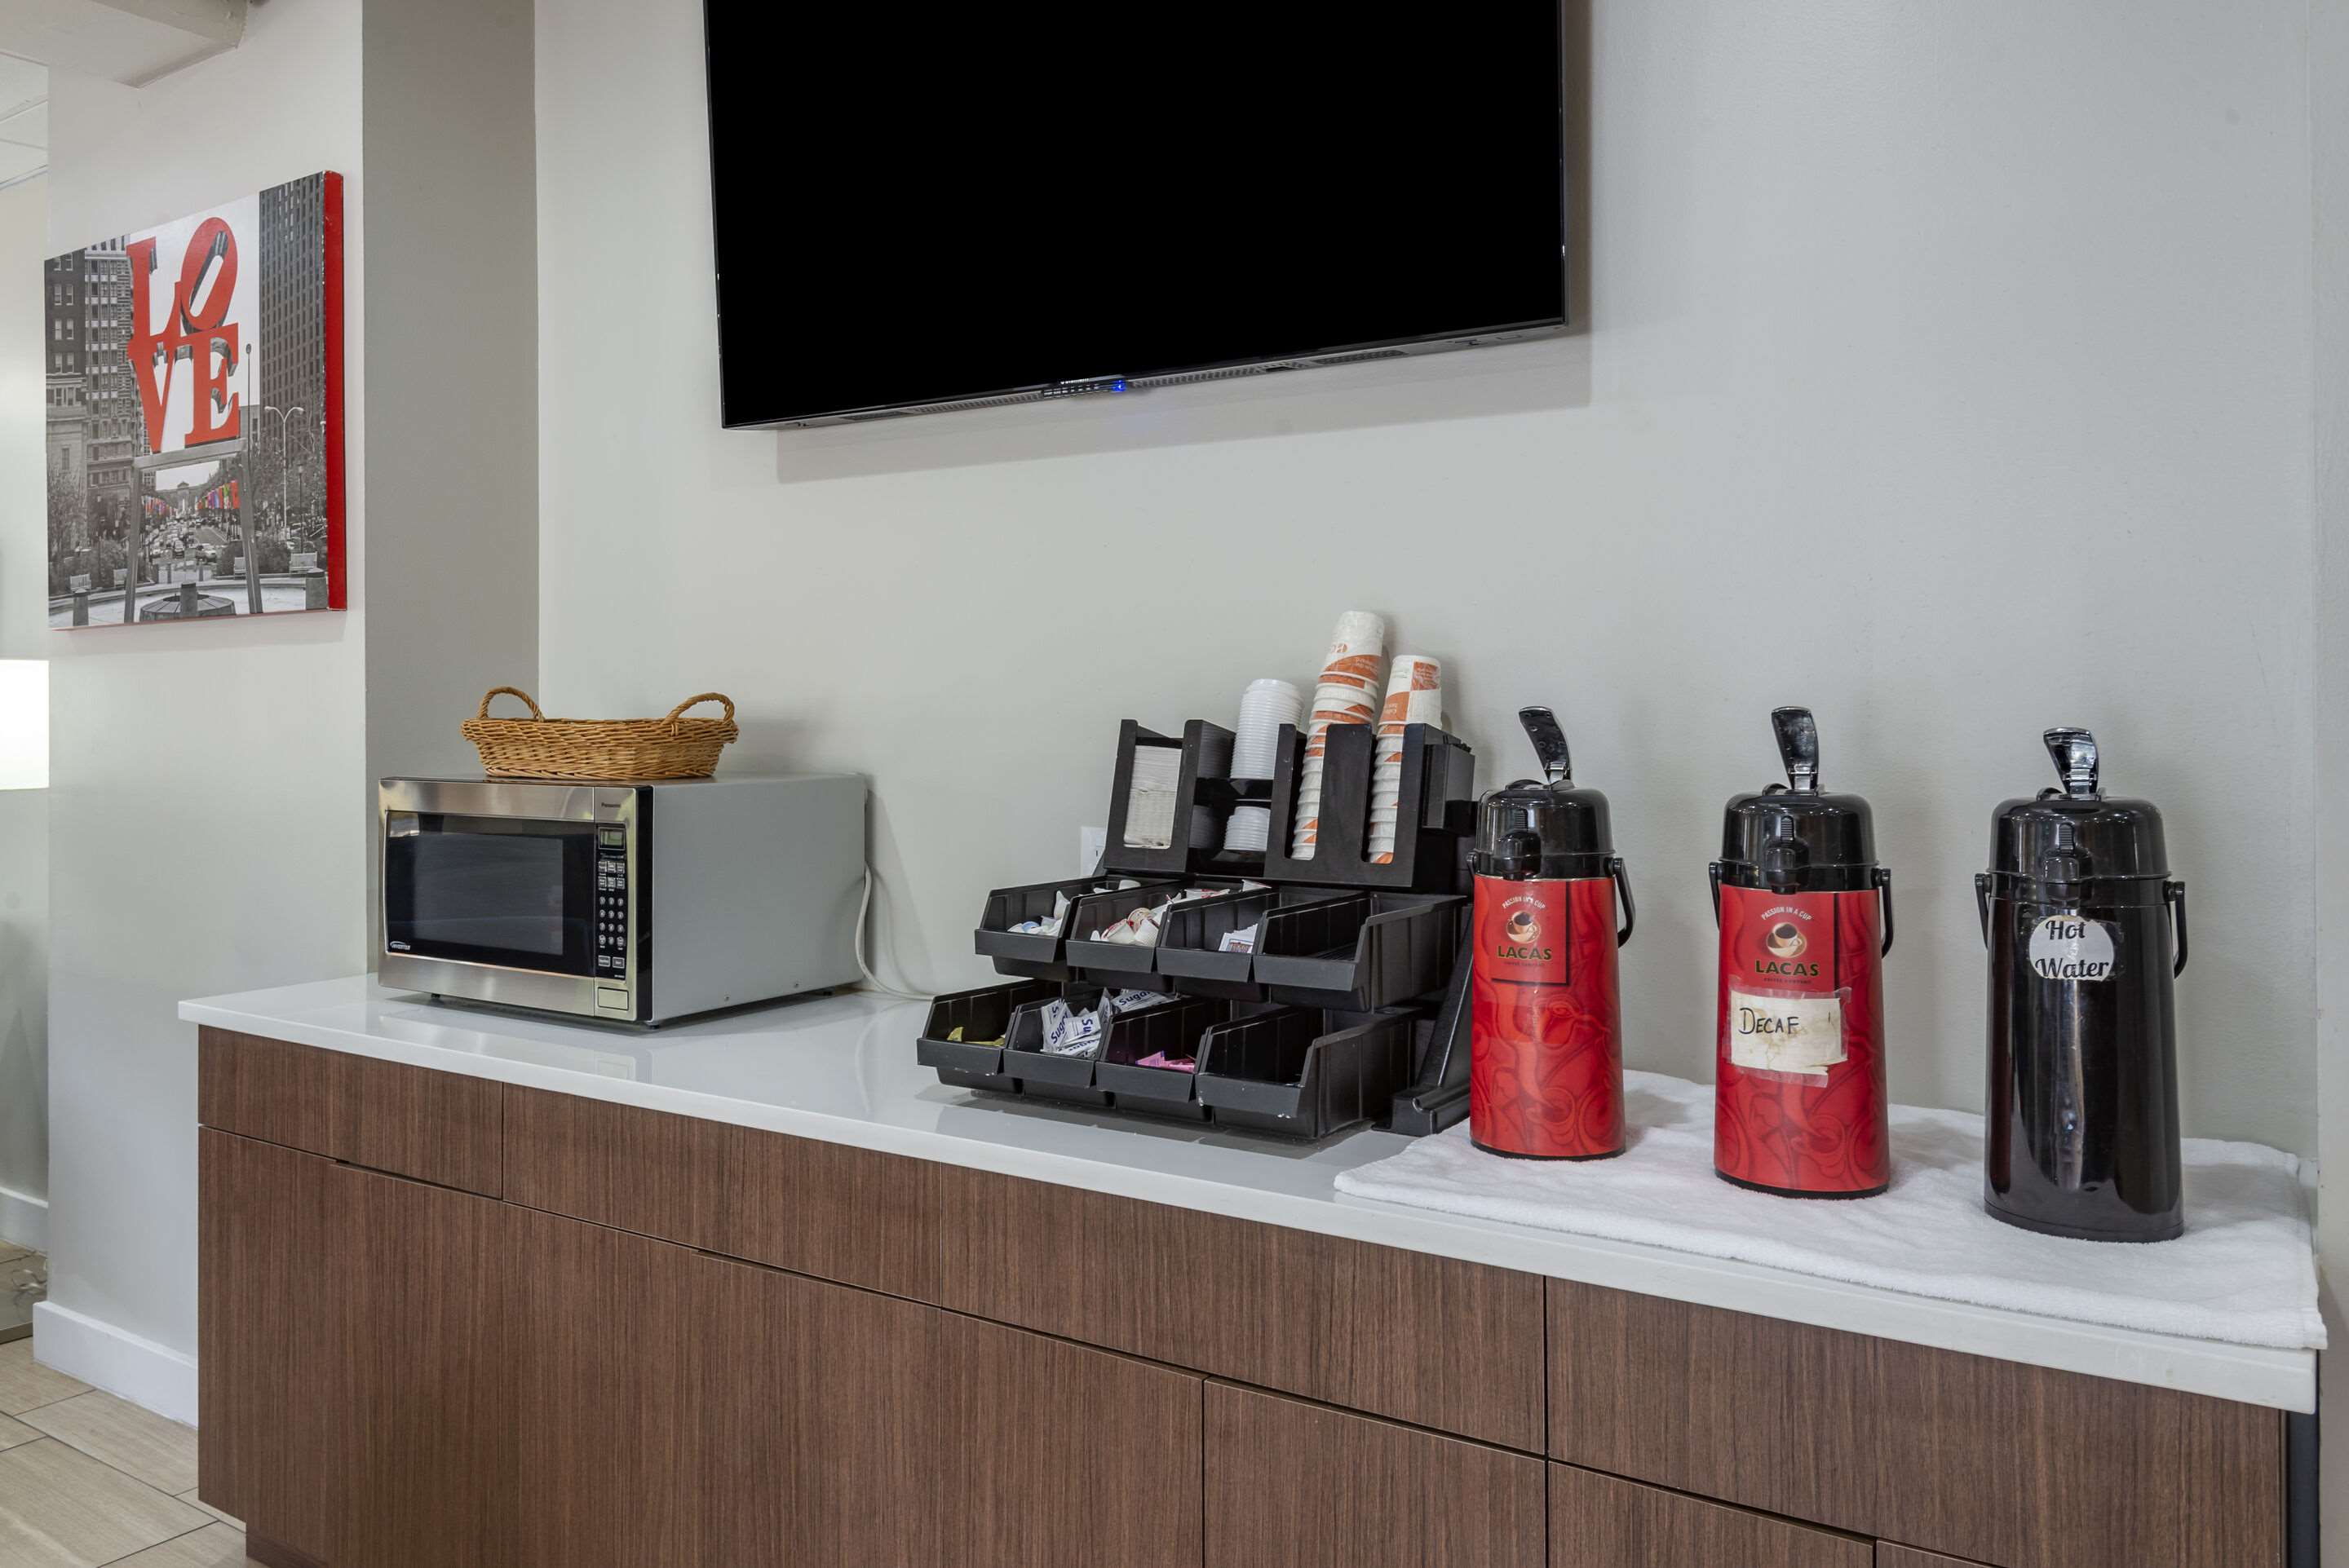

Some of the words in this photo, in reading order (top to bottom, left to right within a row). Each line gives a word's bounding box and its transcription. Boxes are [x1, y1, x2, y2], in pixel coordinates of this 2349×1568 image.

[1761, 906, 1785, 920] PASSION
[1799, 911, 1812, 920] CUP
[2045, 920, 2086, 939] Hot
[1497, 945, 1553, 961] LACAS
[1755, 960, 1819, 976] LACAS
[2034, 957, 2109, 978] Water
[1738, 1007, 1799, 1035] DECAF
